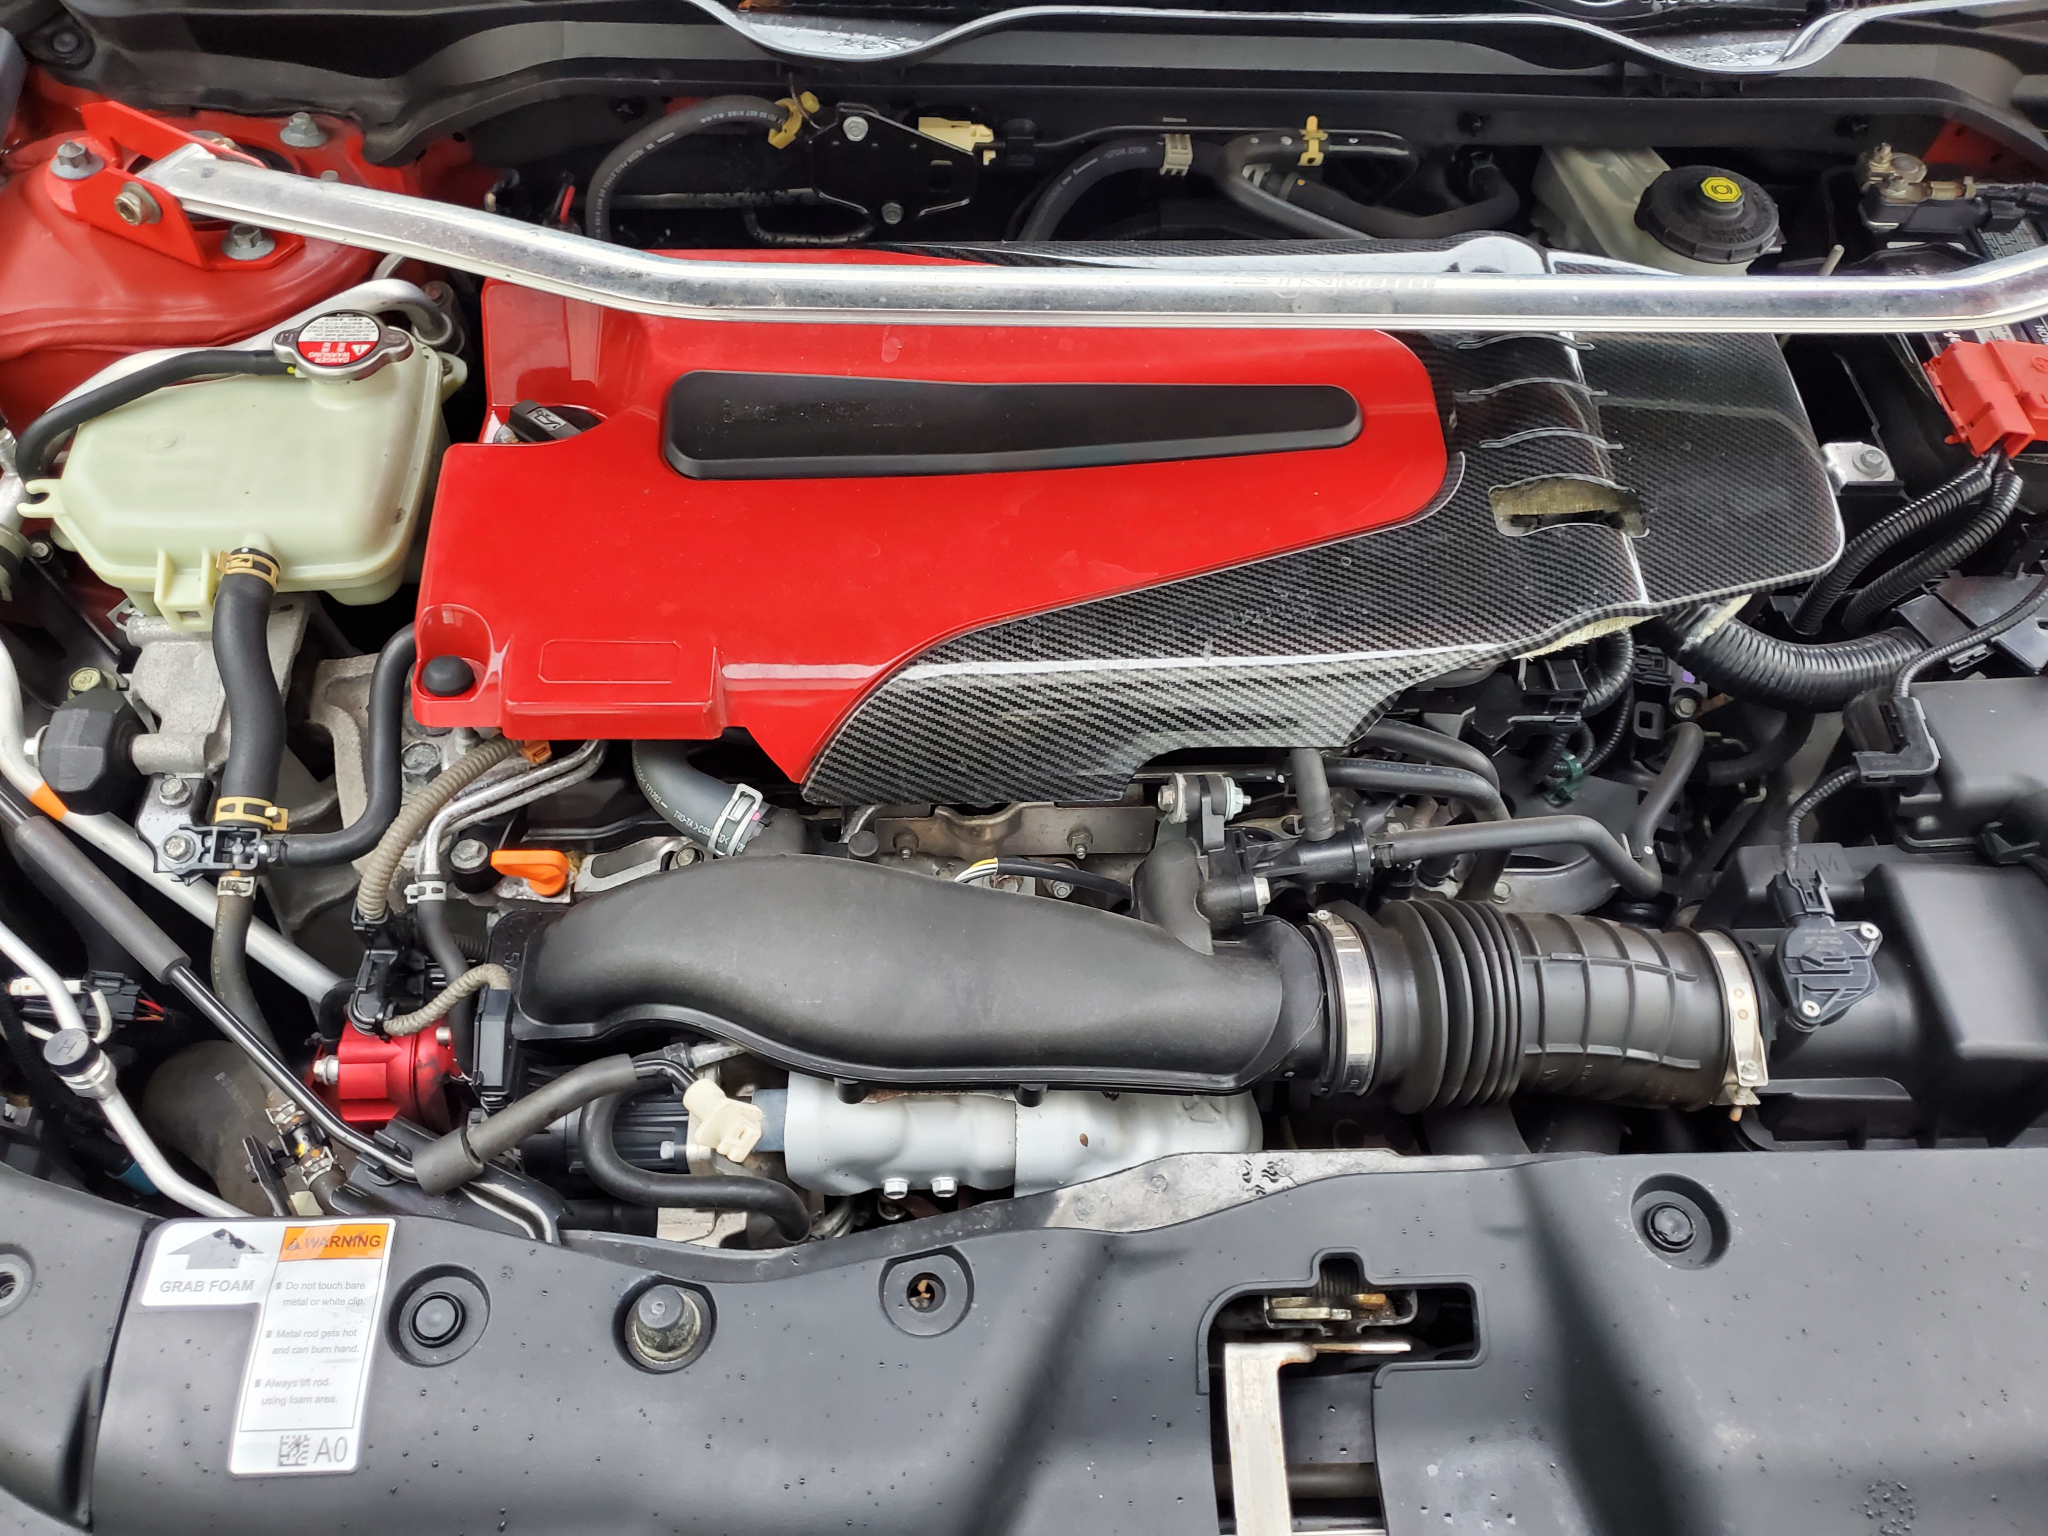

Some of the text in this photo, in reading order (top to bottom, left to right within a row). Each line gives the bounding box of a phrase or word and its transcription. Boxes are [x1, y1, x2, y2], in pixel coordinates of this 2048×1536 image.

[305, 1234, 381, 1249] WARNING
[160, 1279, 255, 1293] GRAB FOAM
[285, 1281, 366, 1290] Do not touch bare
[282, 1298, 308, 1306] metal
[322, 1297, 346, 1306] white
[348, 1297, 366, 1307] clip.
[275, 1328, 357, 1339] Metal rod gets hot
[271, 1344, 359, 1354] and can burn hand.
[264, 1378, 329, 1389] Always lift rod
[261, 1395, 338, 1406] using foam area.
[313, 1436, 348, 1463] A0
